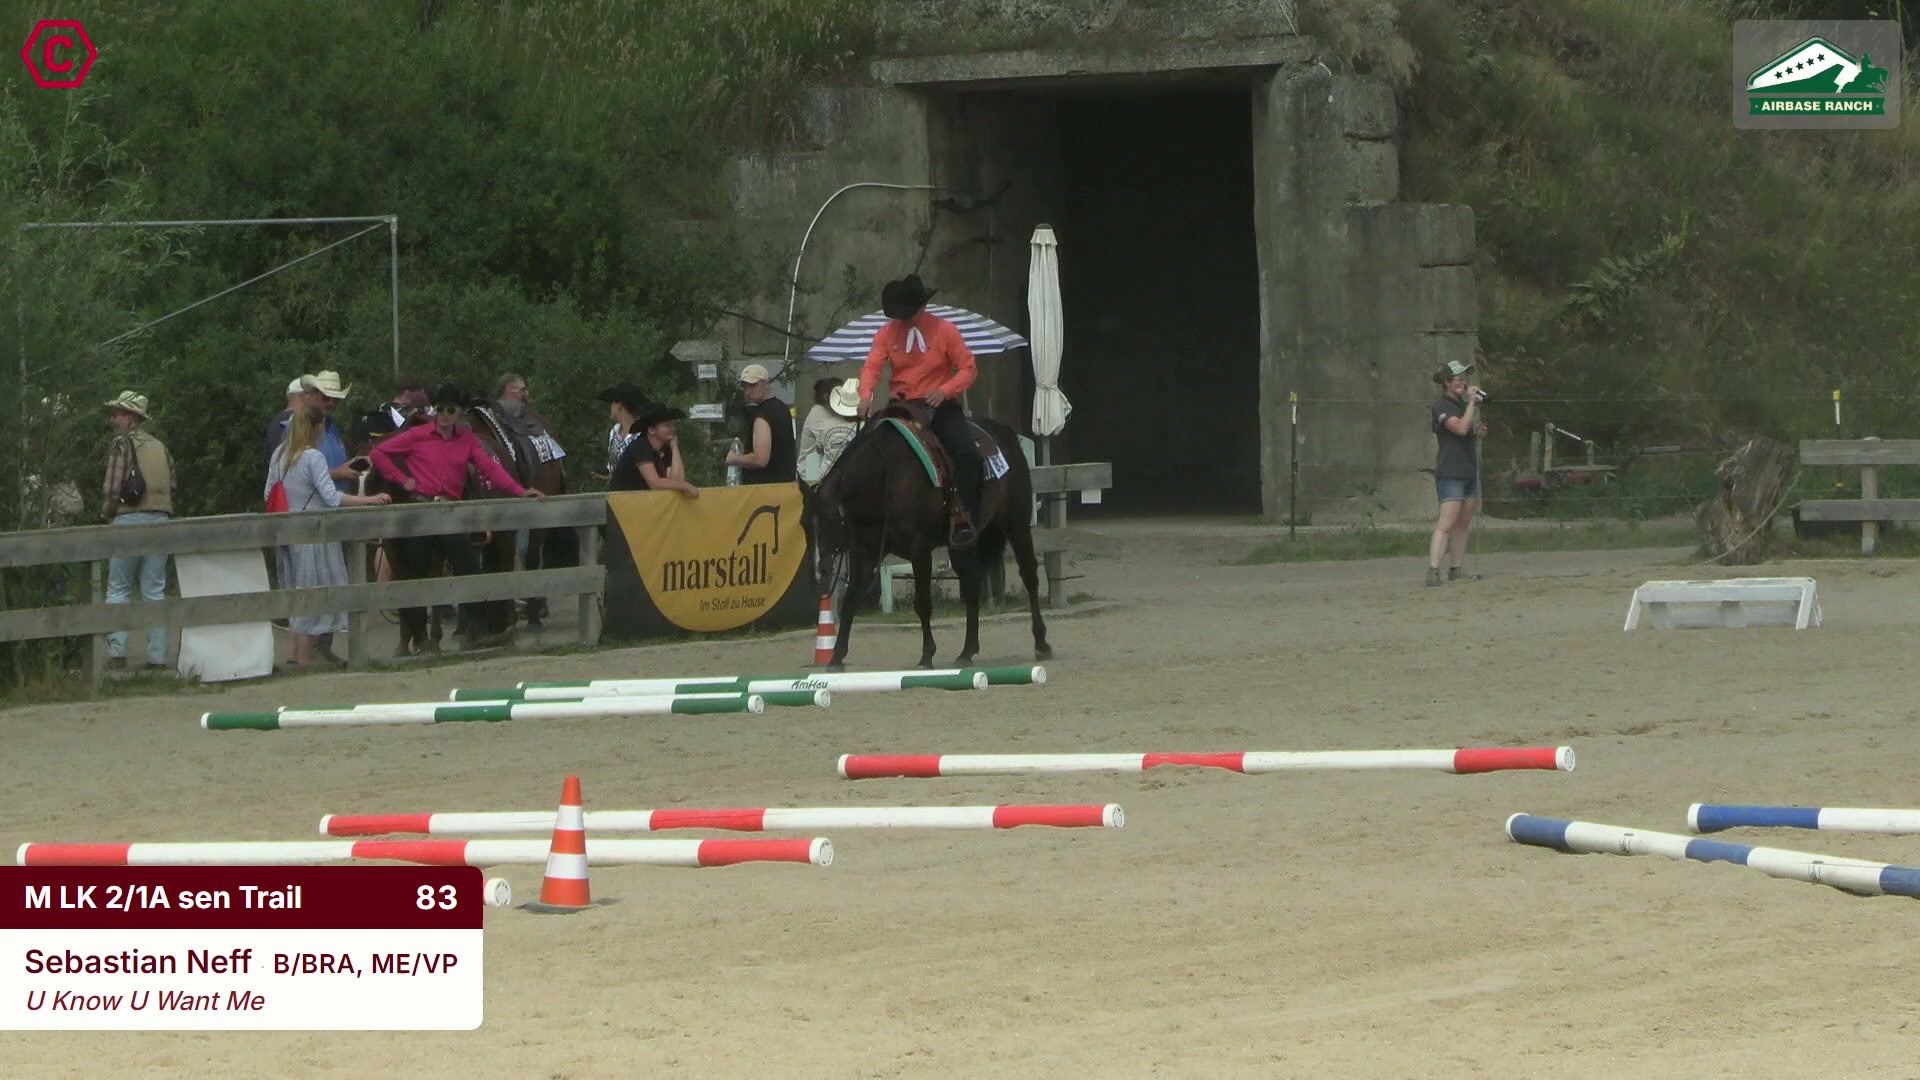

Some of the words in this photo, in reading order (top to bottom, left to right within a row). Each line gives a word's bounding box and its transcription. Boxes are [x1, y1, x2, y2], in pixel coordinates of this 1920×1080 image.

[662, 543, 768, 592] marstall
[700, 600, 710, 612] Im
[730, 599, 740, 610] zu
